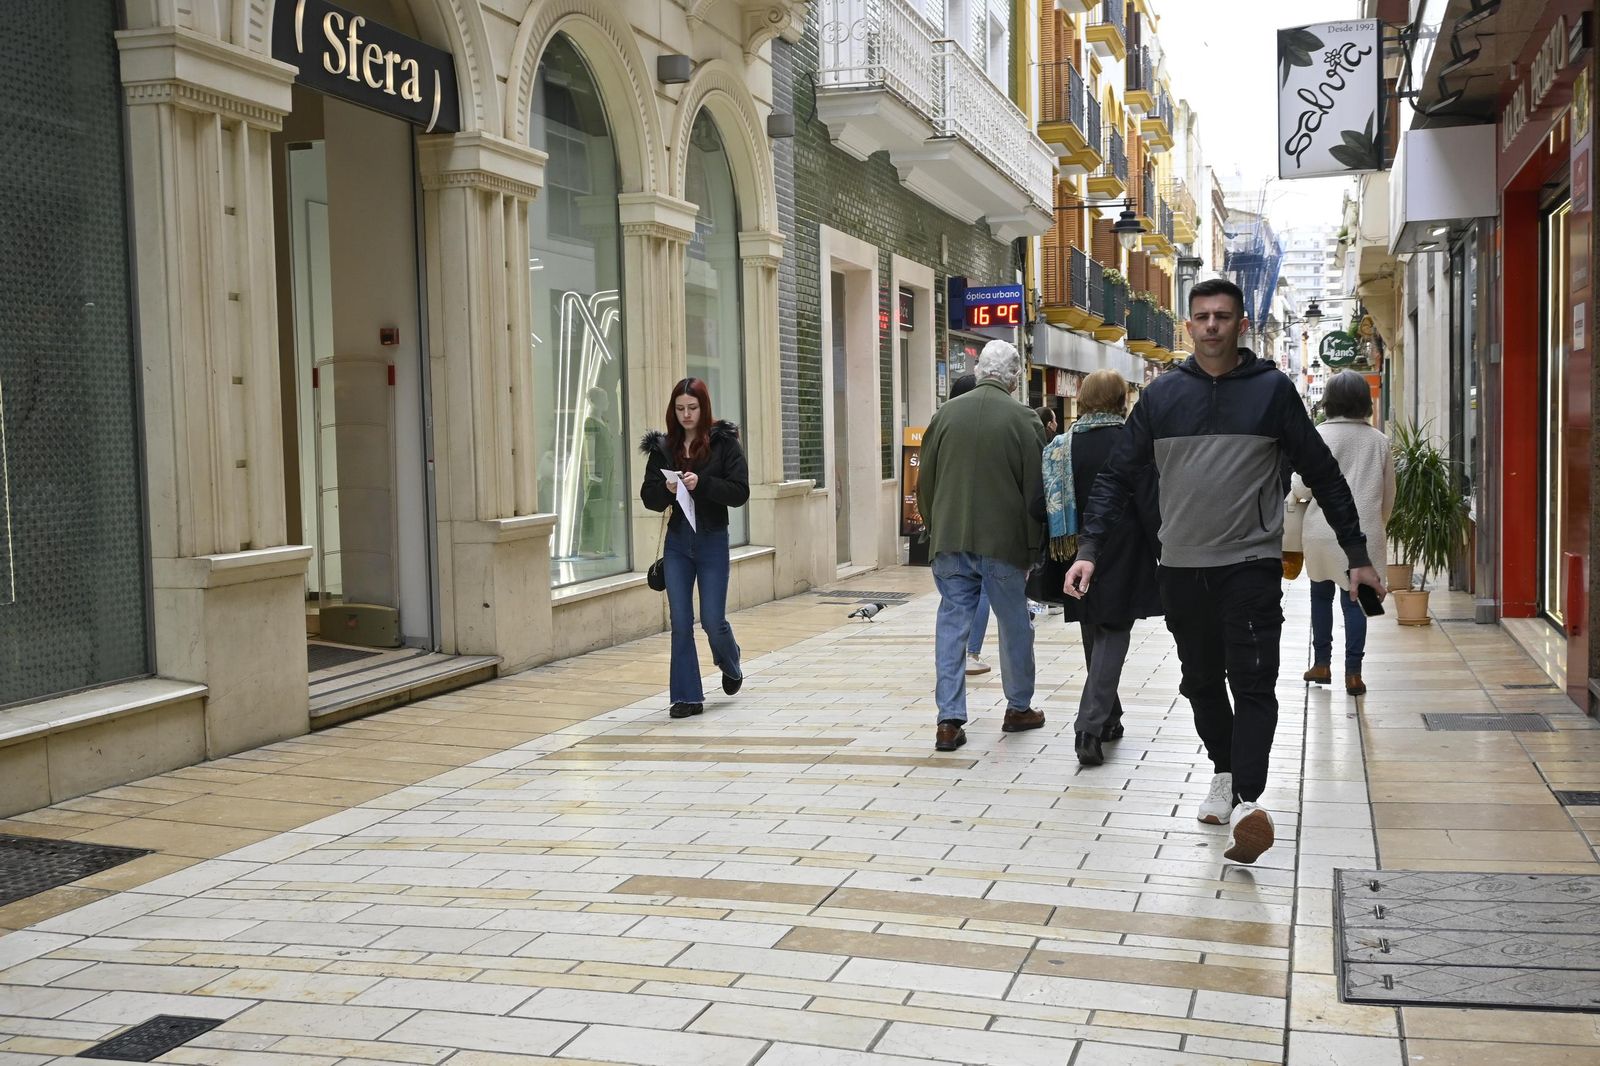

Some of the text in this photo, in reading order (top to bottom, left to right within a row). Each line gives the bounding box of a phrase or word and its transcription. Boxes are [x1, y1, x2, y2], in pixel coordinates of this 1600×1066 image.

[1327, 23, 1375, 33] Desde 1992
[966, 290, 1020, 301] óptica urbano
[974, 306, 989, 325] 16
